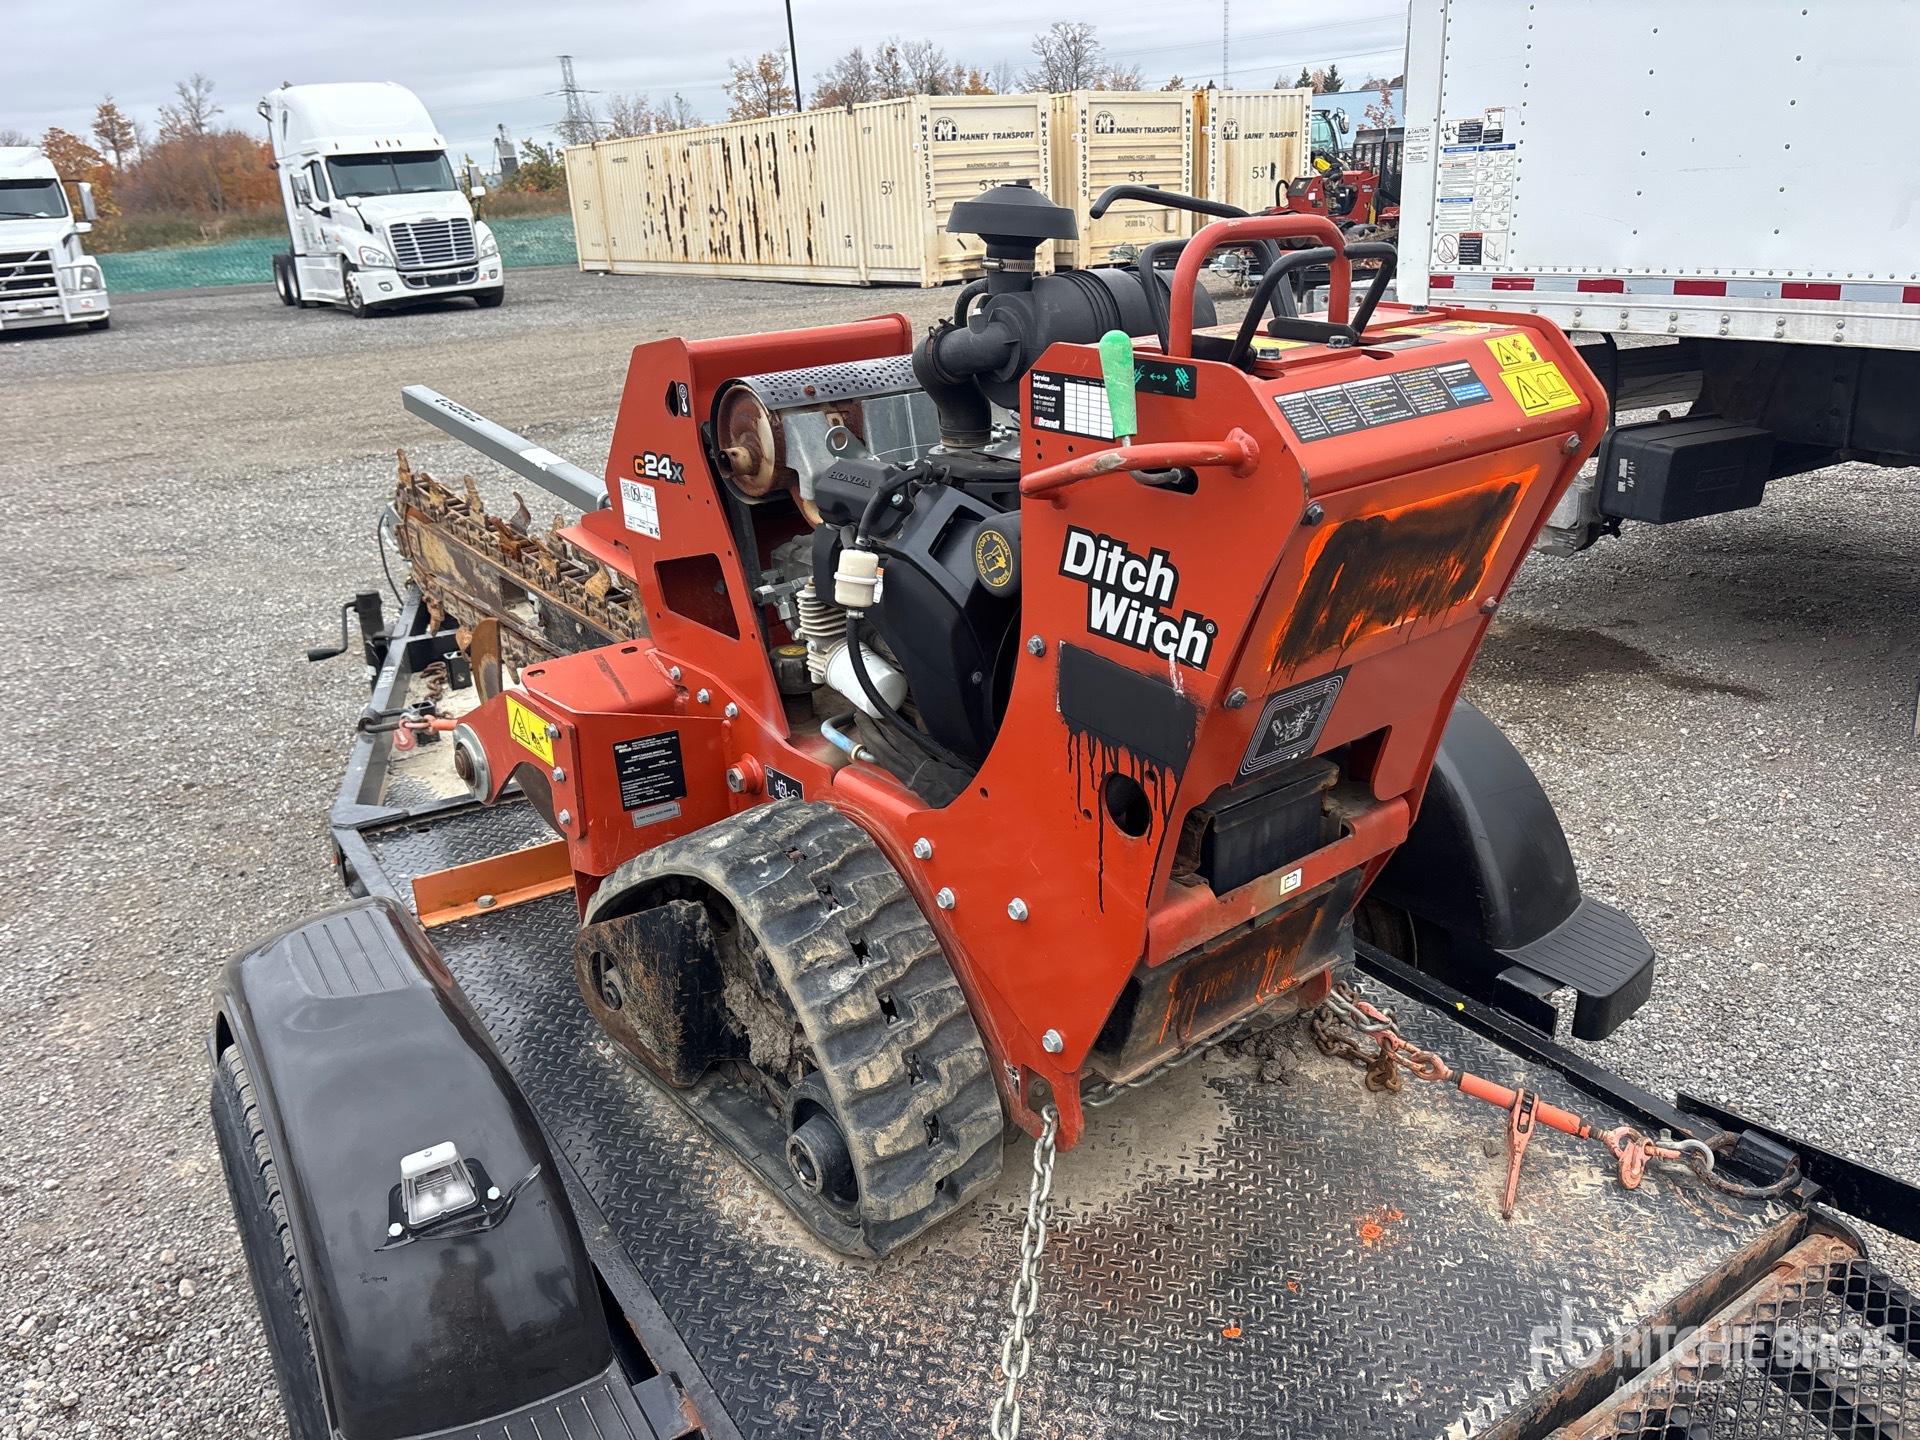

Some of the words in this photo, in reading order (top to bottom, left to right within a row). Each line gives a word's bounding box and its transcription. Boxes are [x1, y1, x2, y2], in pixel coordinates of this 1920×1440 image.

[960, 133, 989, 141] MANNEY
[993, 131, 1034, 140] TRANSPORT
[920, 115, 932, 208] MNXU216573
[828, 471, 871, 488] HONDA
[992, 533, 1010, 557] MANUAL
[1063, 531, 1175, 602] Ditch
